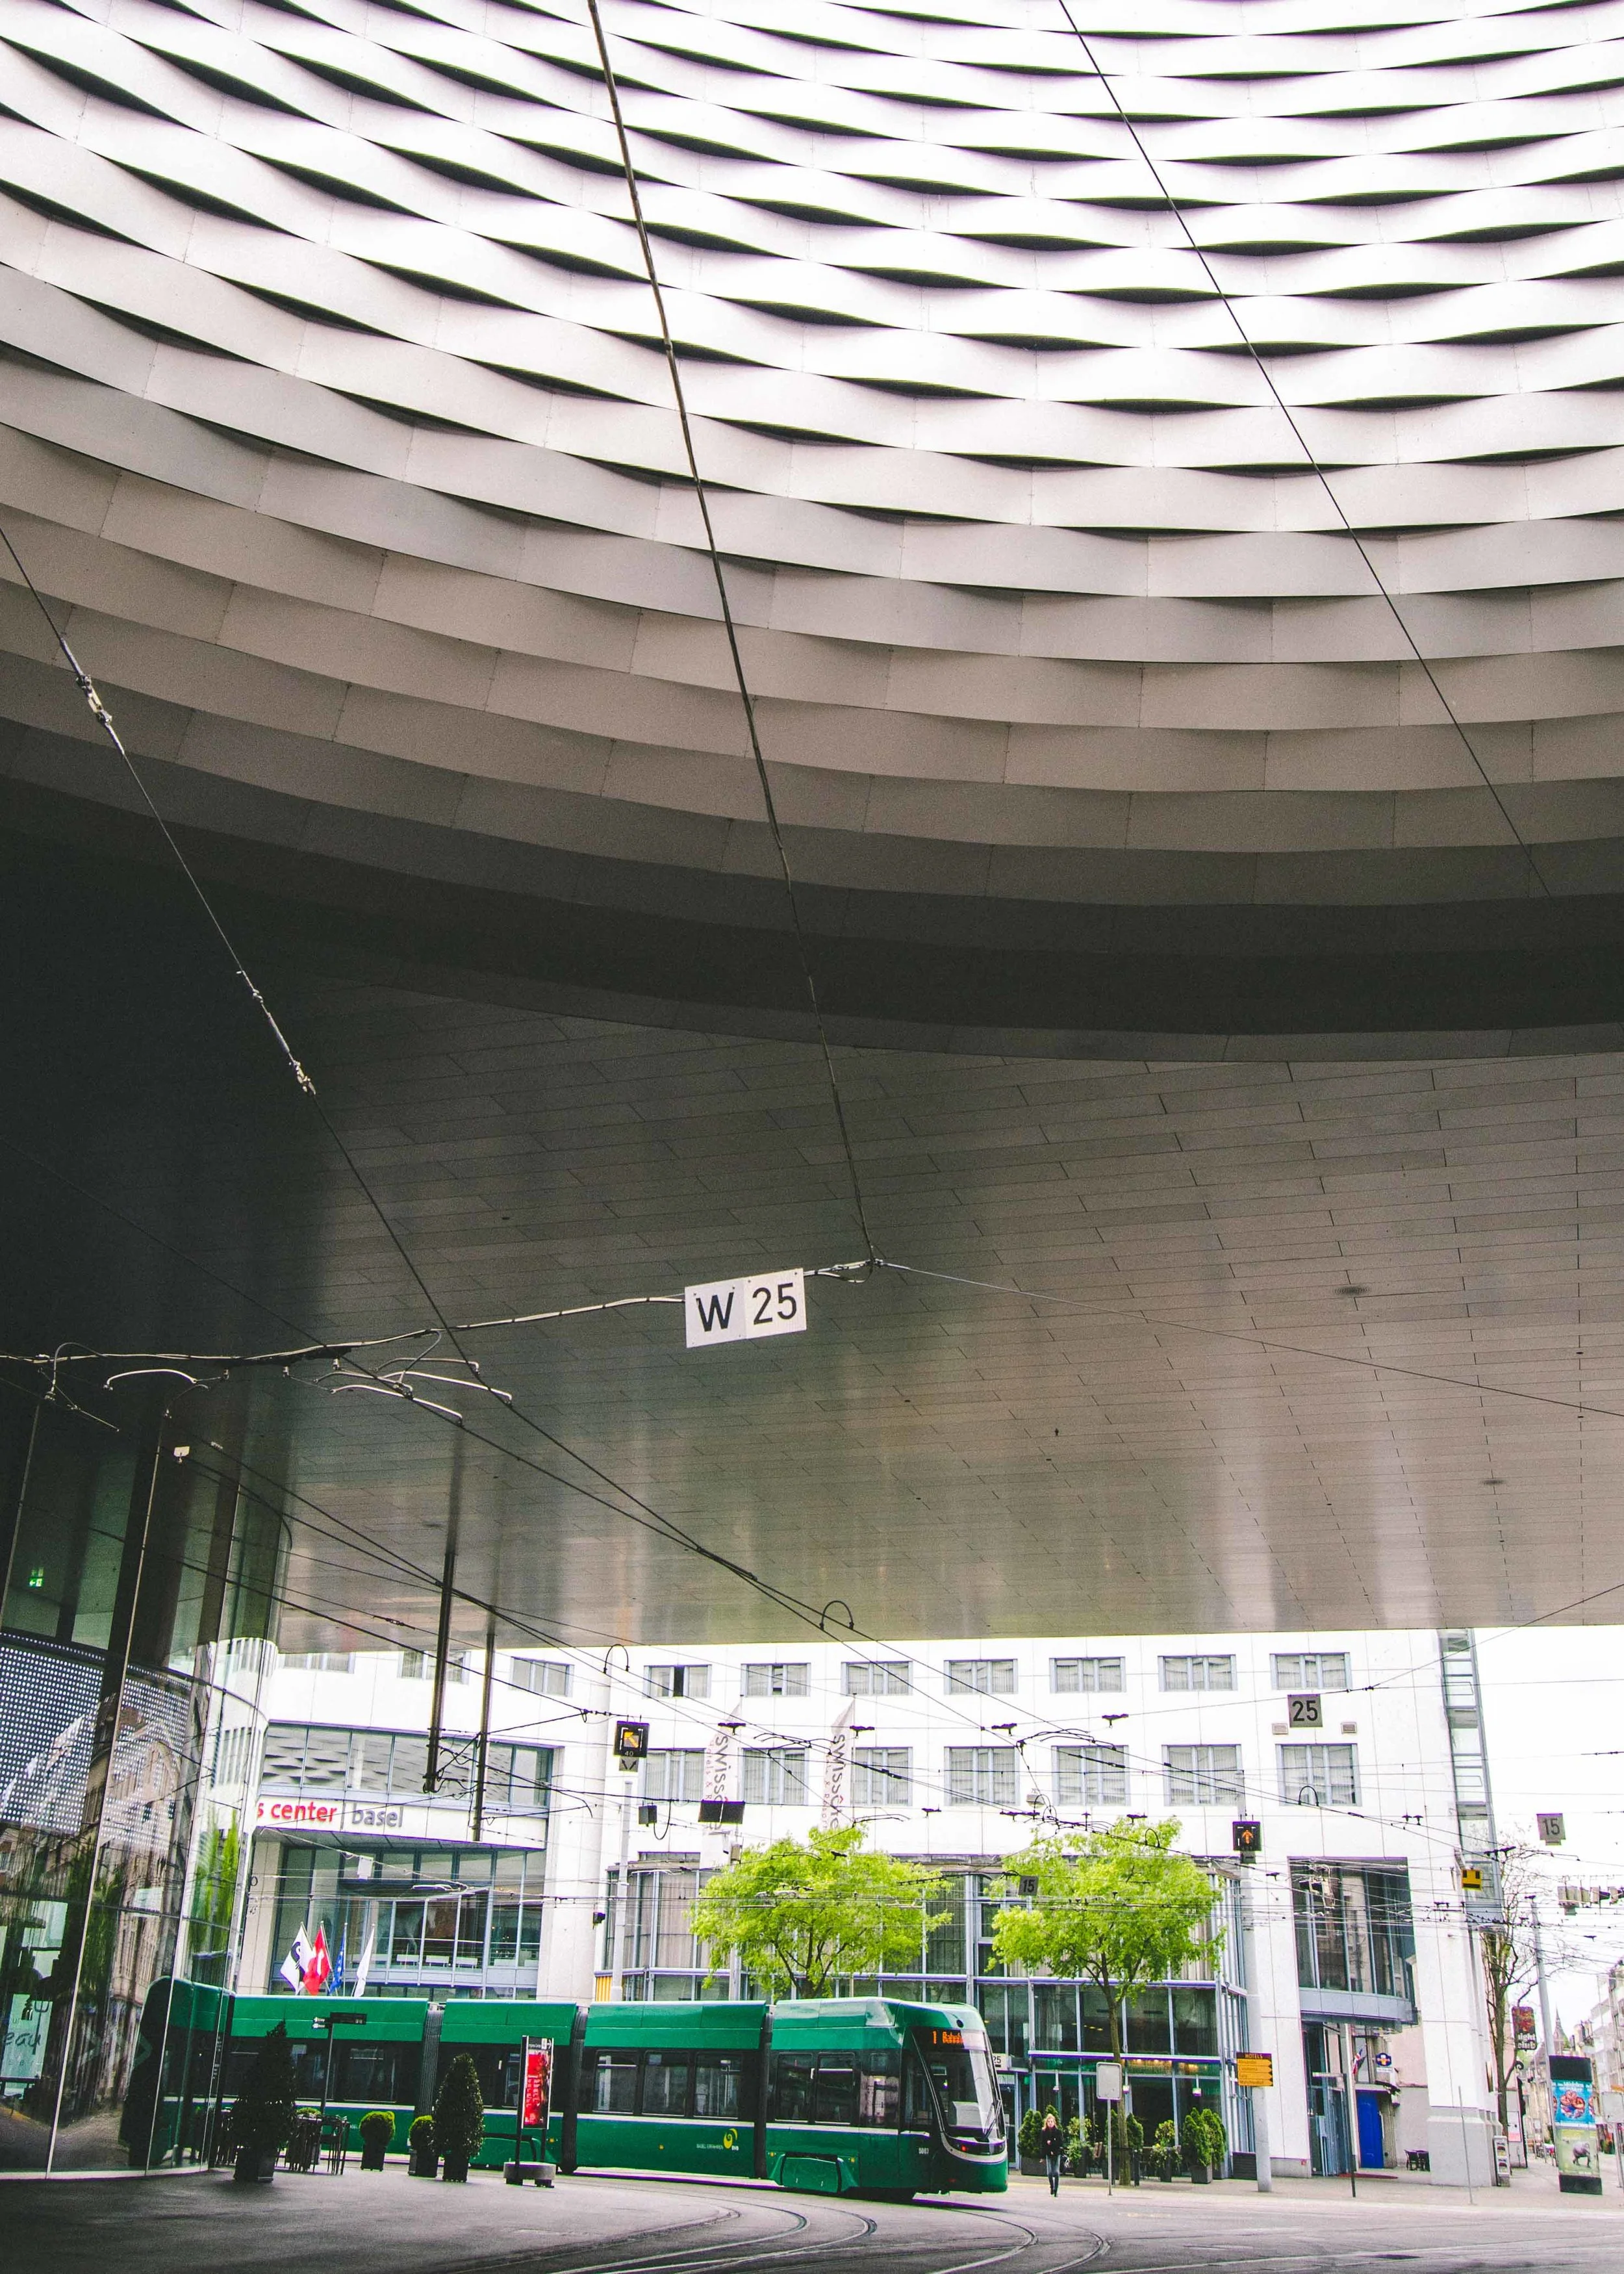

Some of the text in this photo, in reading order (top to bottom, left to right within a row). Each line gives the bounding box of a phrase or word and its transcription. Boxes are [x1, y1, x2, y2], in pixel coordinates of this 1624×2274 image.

[696, 1282, 797, 1332] W 25
[1292, 1700, 1318, 1722] 25
[270, 1801, 337, 1823] center
[351, 1802, 404, 1828] basel
[1542, 1817, 1560, 1835] 15
[1023, 1879, 1035, 1893] 15
[932, 2030, 937, 2045] 1
